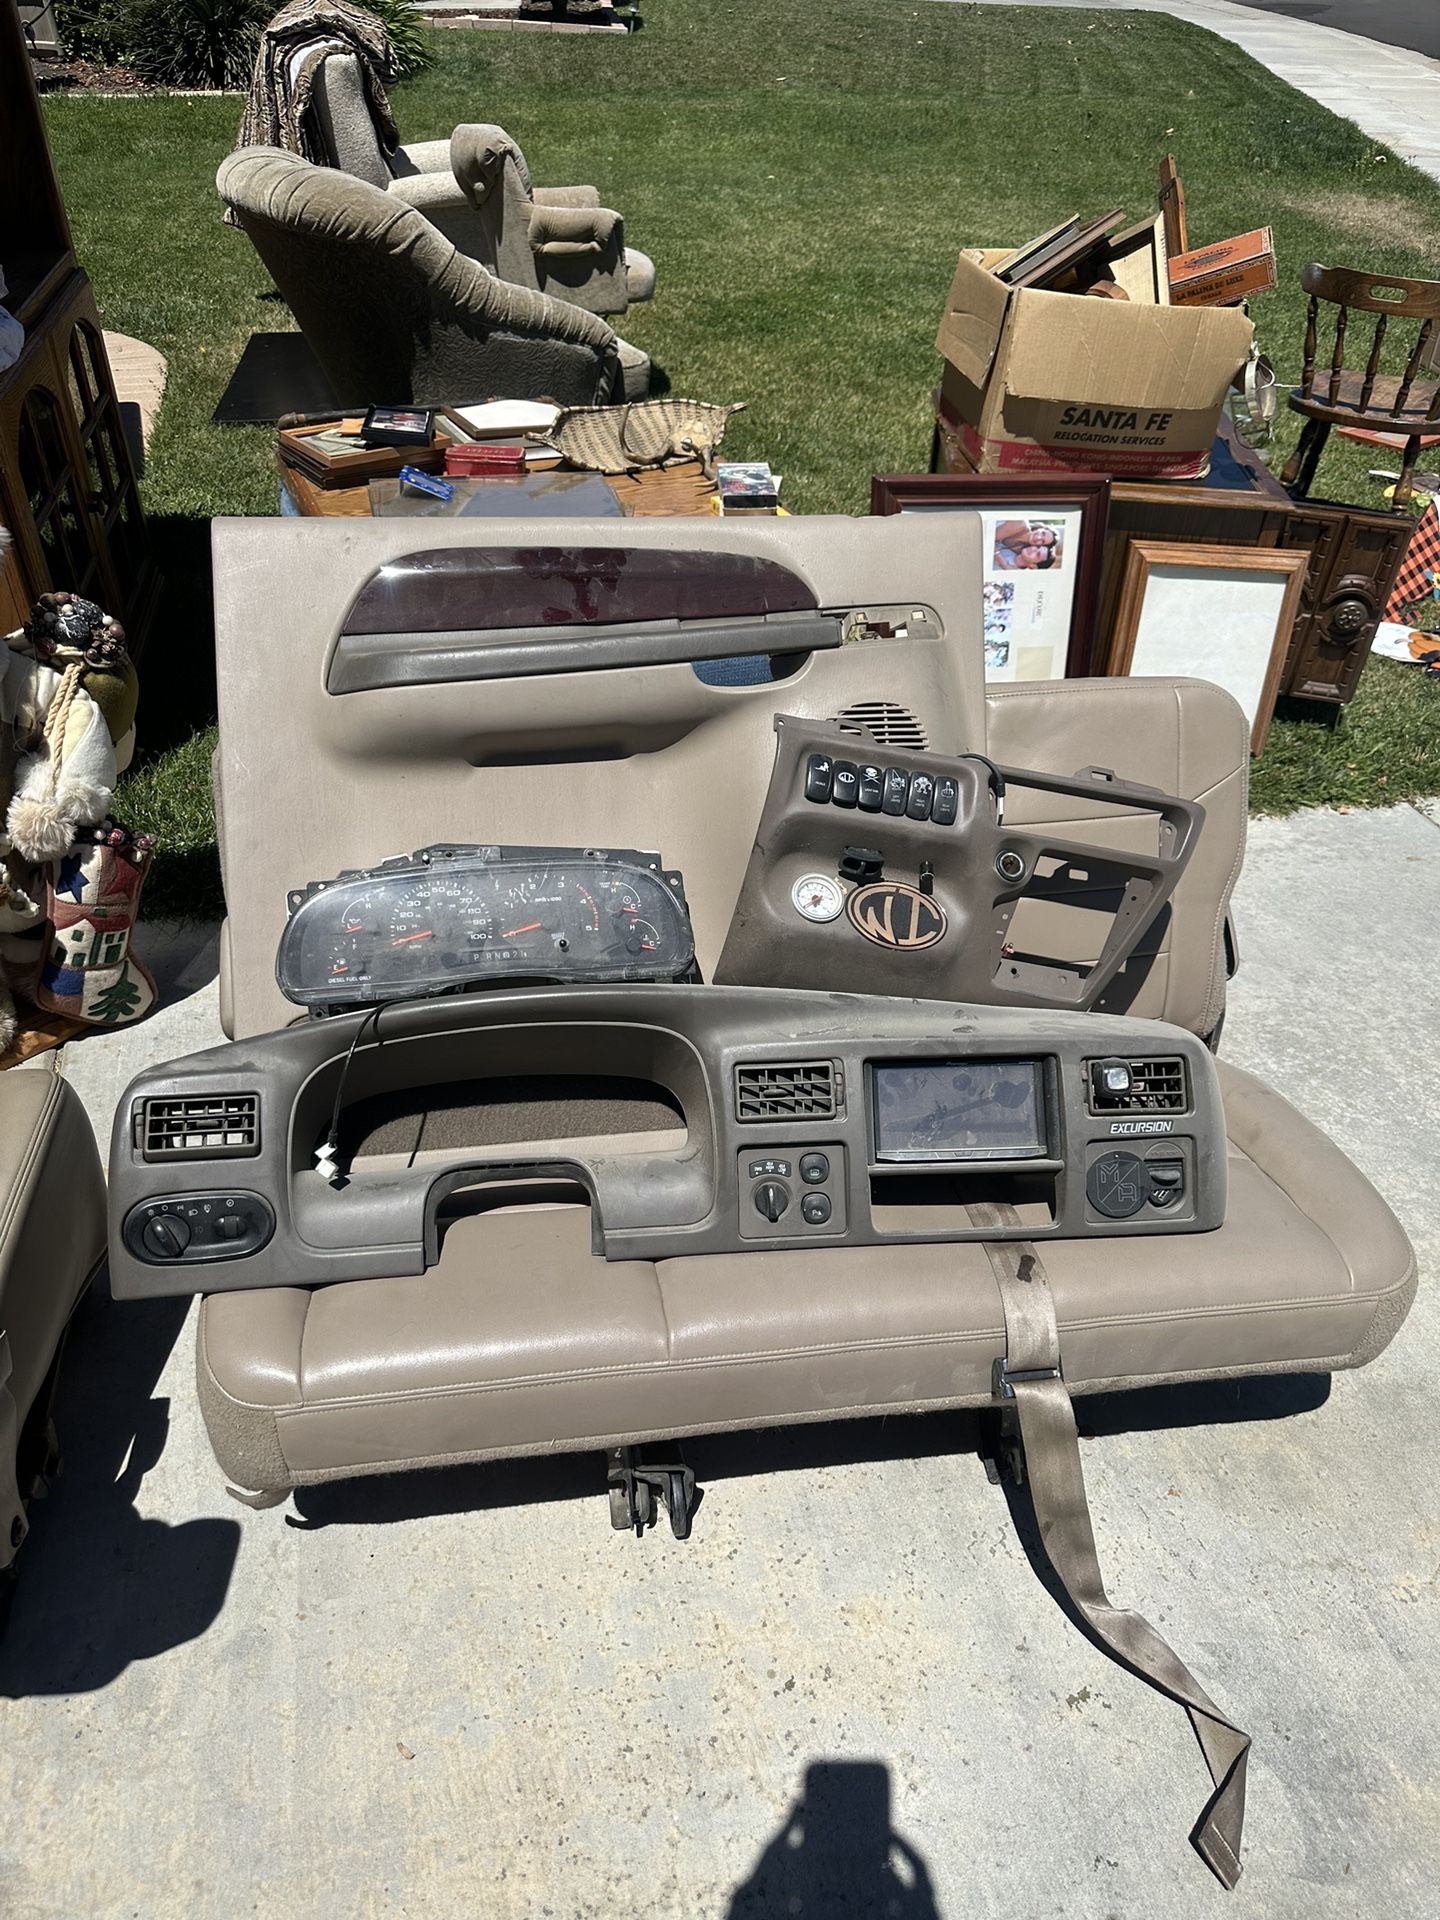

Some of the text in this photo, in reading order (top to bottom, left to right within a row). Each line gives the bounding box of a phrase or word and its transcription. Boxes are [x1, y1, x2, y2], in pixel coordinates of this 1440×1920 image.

[1176, 291, 1186, 301] LA
[1059, 406, 1173, 431] SANTA FE
[1053, 430, 1167, 447] RELOCATION SERVICES
[1110, 1121, 1173, 1134] EXCURSION
